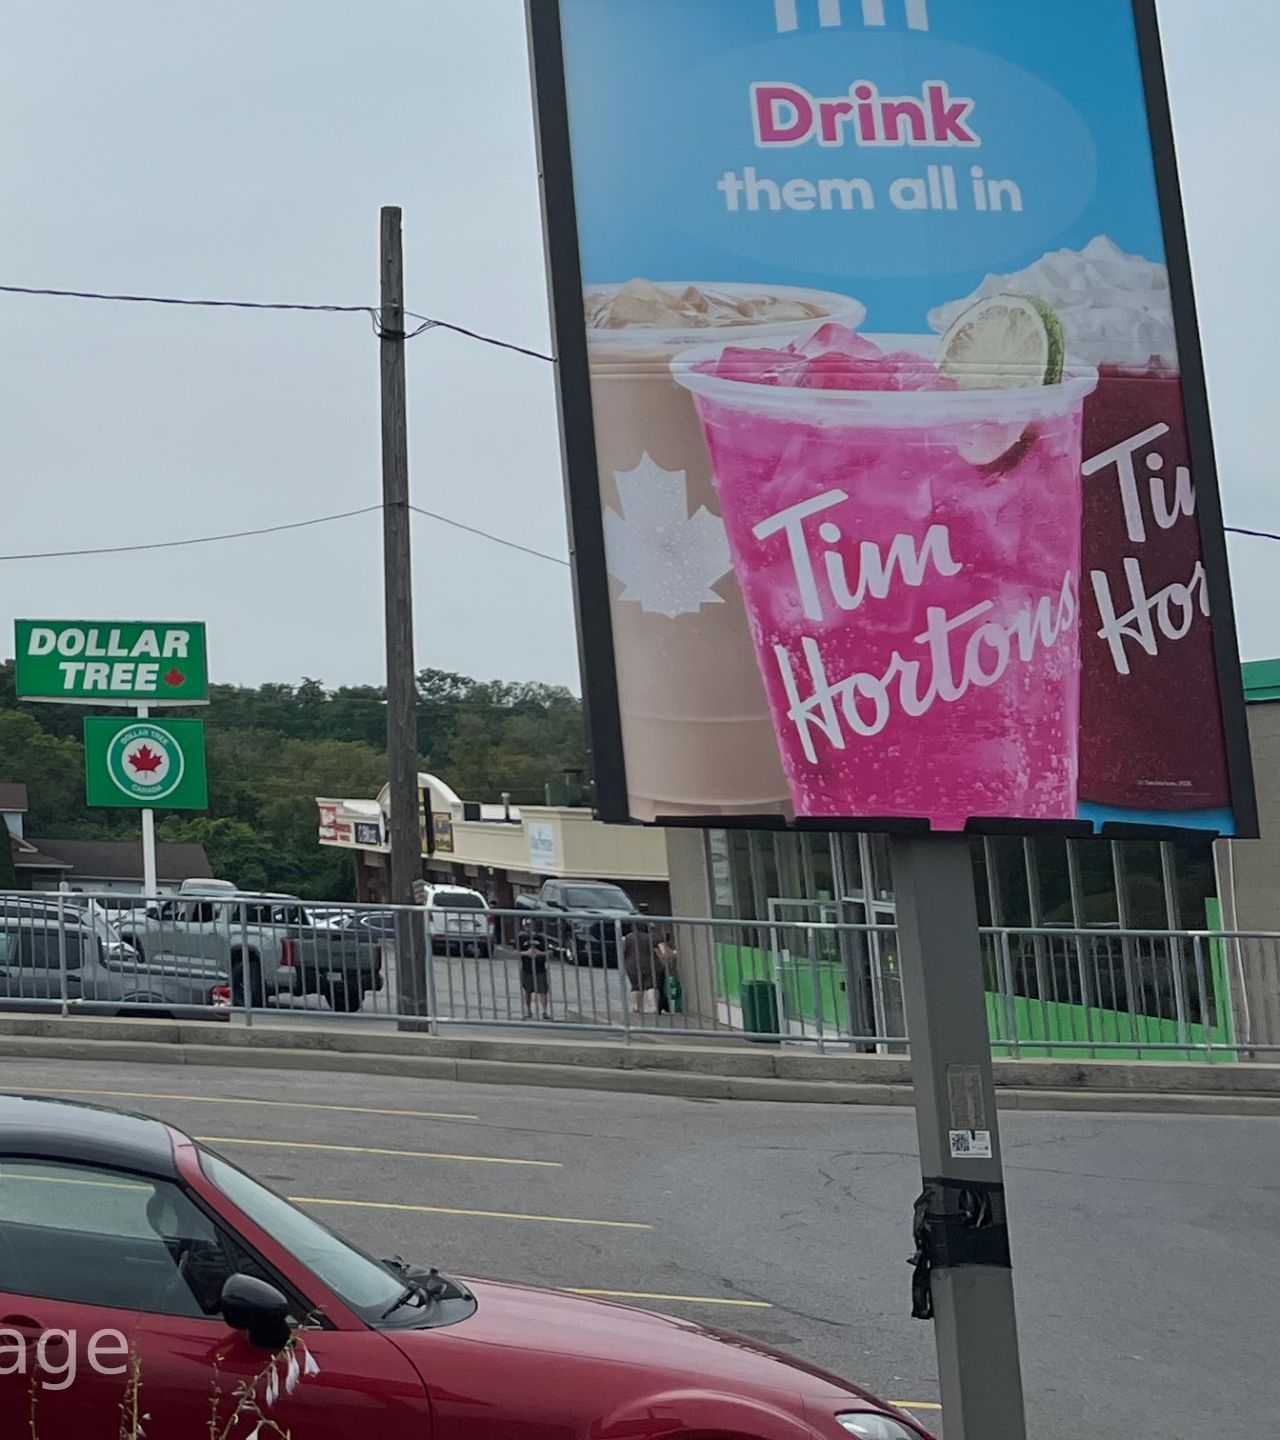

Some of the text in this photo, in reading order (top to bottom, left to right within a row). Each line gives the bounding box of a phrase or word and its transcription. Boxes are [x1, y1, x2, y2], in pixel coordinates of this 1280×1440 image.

[752, 81, 980, 147] Drink
[717, 164, 1024, 211] them all in
[751, 488, 963, 622] Tim
[28, 627, 190, 658] DOLLAR
[58, 661, 160, 691] TREE
[773, 569, 1076, 765] Hortons
[120, 729, 170, 746] DOLLAR TREE
[131, 784, 163, 793] CANADA
